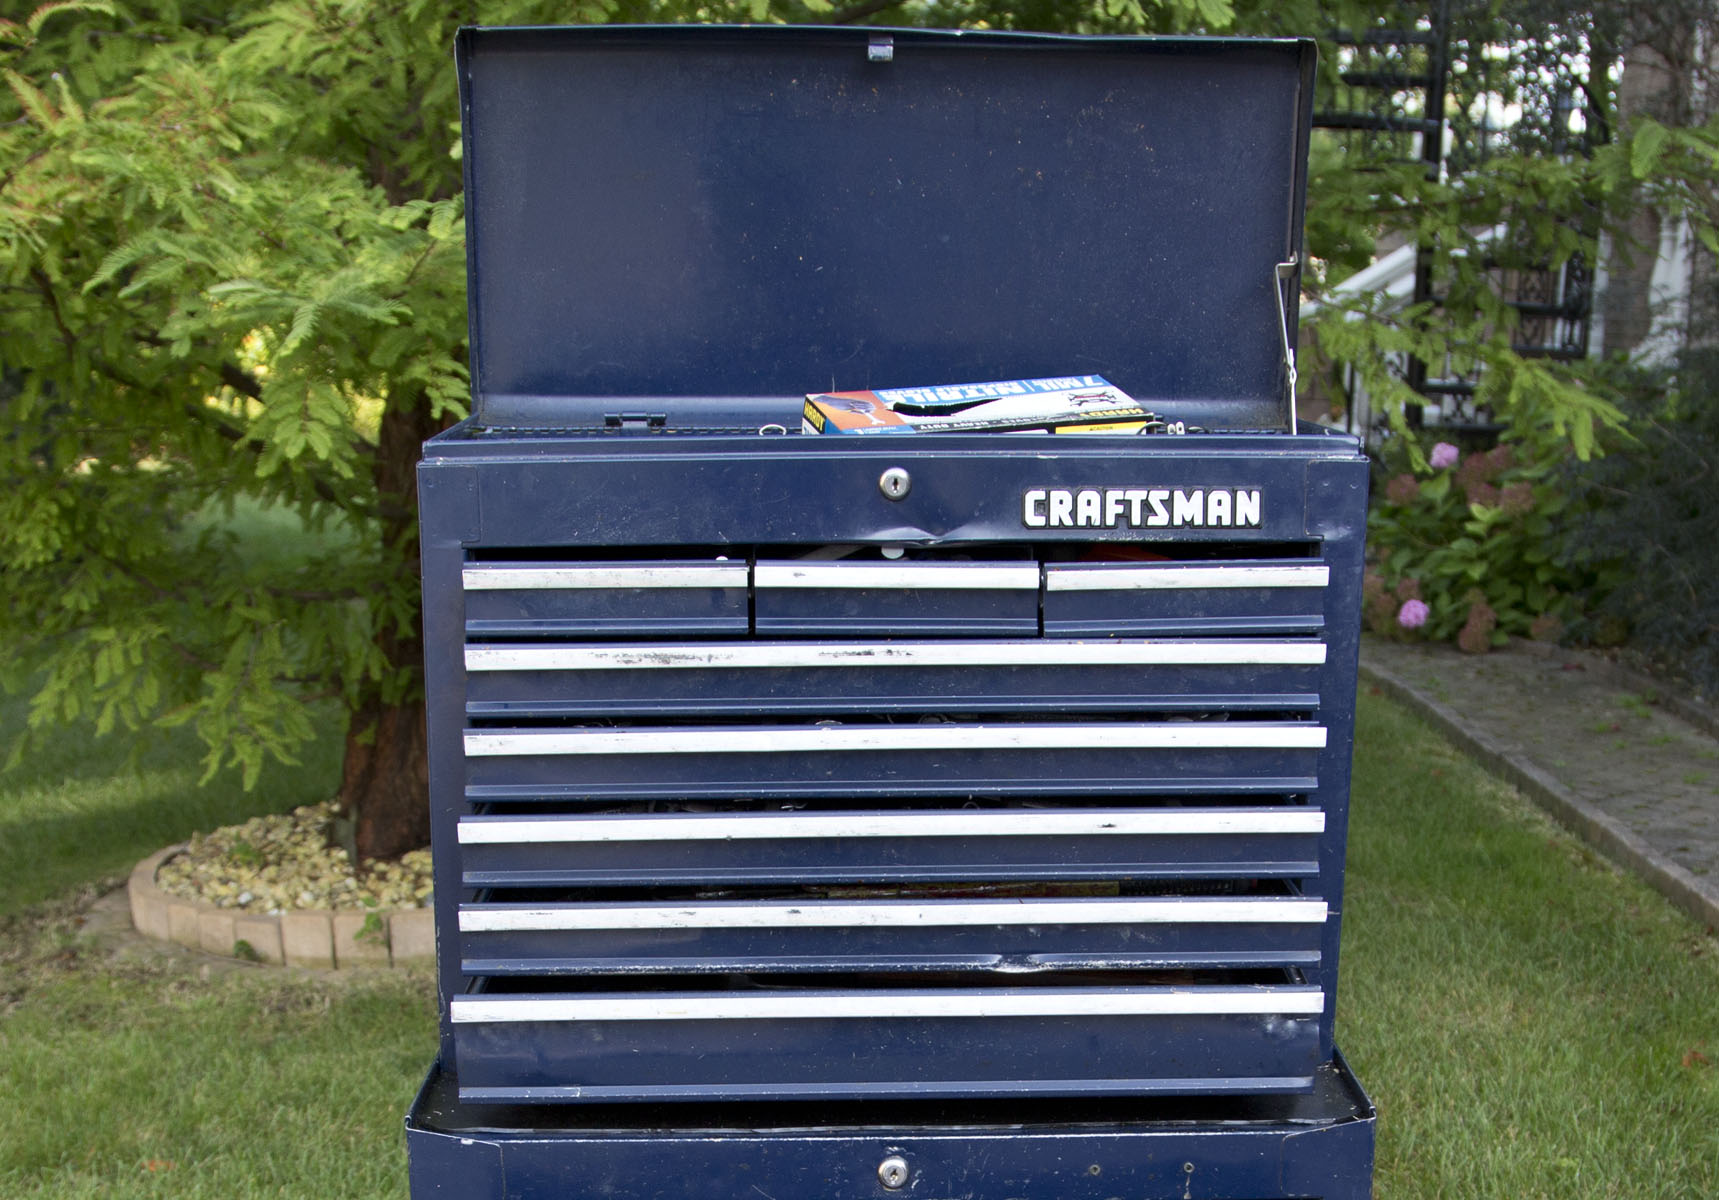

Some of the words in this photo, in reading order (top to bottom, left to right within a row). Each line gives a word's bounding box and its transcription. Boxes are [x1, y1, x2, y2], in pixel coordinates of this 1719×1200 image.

[1032, 378, 1084, 391] MIL
[804, 401, 825, 431] HARDY
[1023, 489, 1261, 527] CRAFTSMAN
